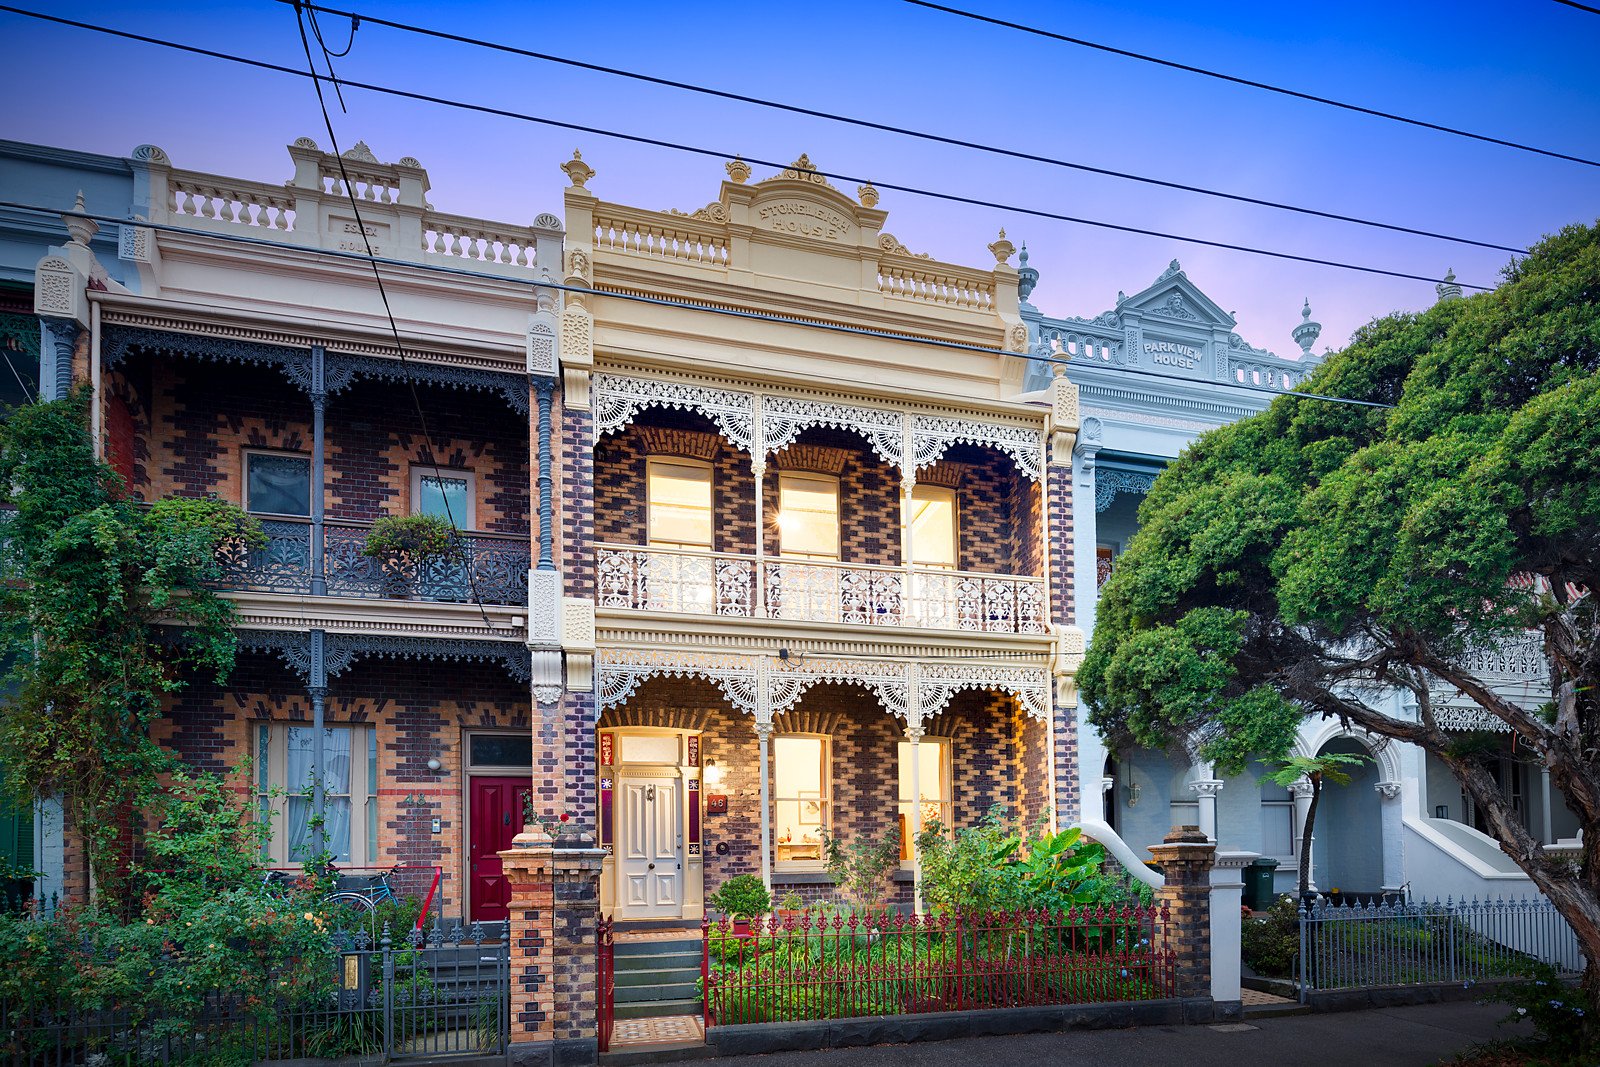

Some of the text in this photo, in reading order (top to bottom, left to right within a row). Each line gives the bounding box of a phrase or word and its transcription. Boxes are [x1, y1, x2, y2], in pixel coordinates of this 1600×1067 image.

[759, 203, 850, 234] STONELEIGH
[772, 218, 838, 240] HOUSE
[1143, 341, 1203, 362] PARK VIEW
[1153, 353, 1194, 369] HOUSE
[404, 792, 426, 806] 48
